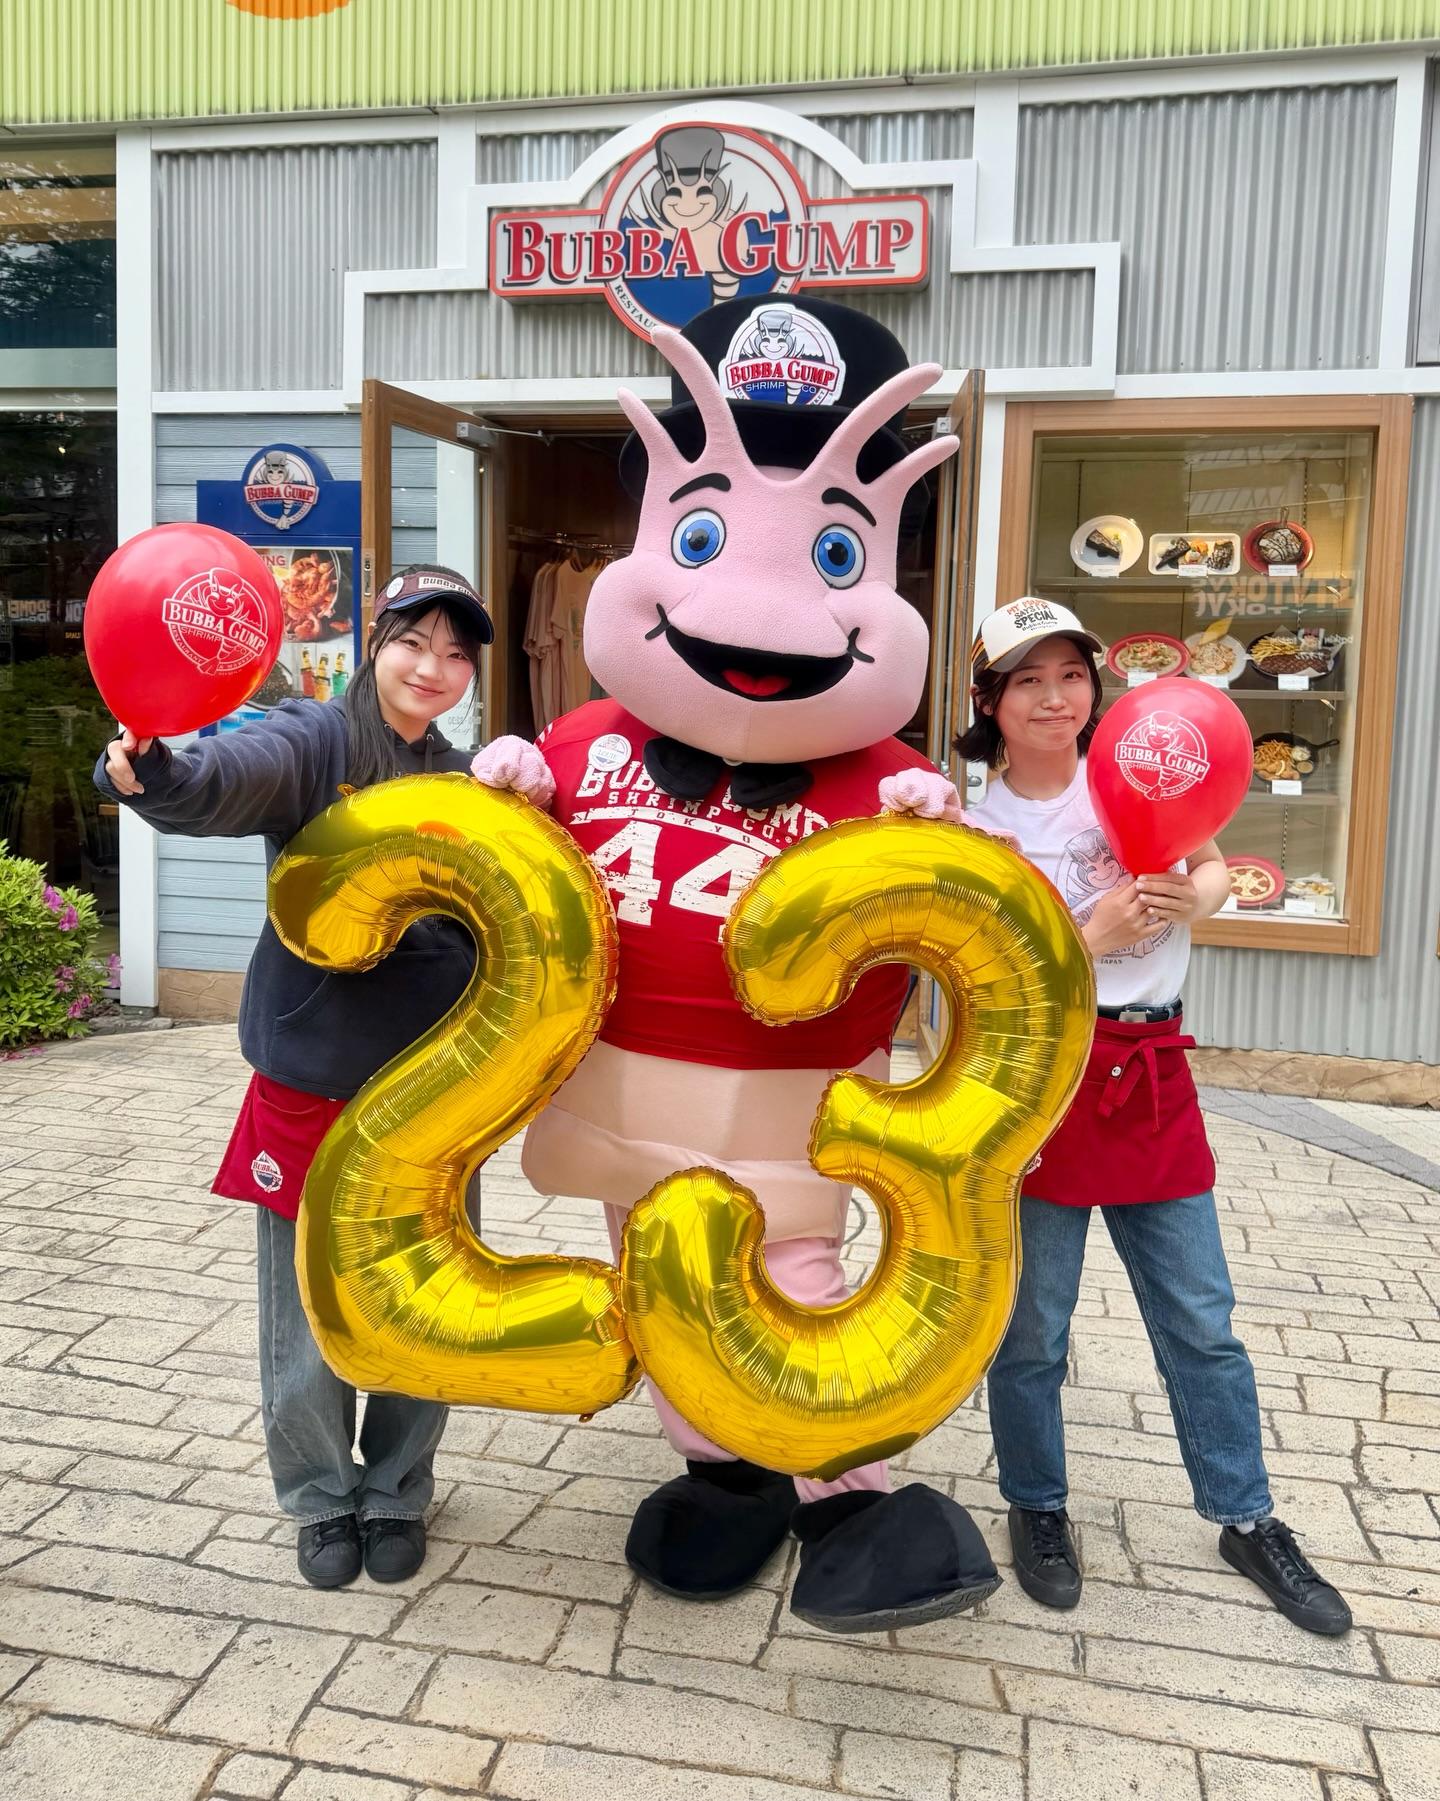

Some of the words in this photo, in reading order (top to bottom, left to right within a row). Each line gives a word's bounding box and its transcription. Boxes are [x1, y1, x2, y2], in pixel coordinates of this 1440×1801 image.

[503, 220, 702, 285] BUBBA
[720, 211, 917, 276] GUMP
[730, 361, 784, 386] BUBBA
[787, 360, 836, 387] GUMP
[745, 381, 786, 392] SHRIMP
[247, 486, 282, 500] BUBBA
[284, 485, 314, 501] GUMP
[169, 602, 224, 634] BUBBA
[228, 621, 265, 650] GUMP
[1014, 605, 1036, 620] SAYS
[1014, 609, 1058, 629] SPECIAL
[181, 626, 221, 642] SHRIMP
[1119, 745, 1161, 764] BUBBA
[1165, 752, 1206, 776] GUMP
[1128, 763, 1161, 772] SHRIMP
[576, 761, 672, 797] BUB
[608, 791, 721, 819] SHRIMP
[631, 808, 751, 844] TOKYO
[589, 820, 767, 927] 44
